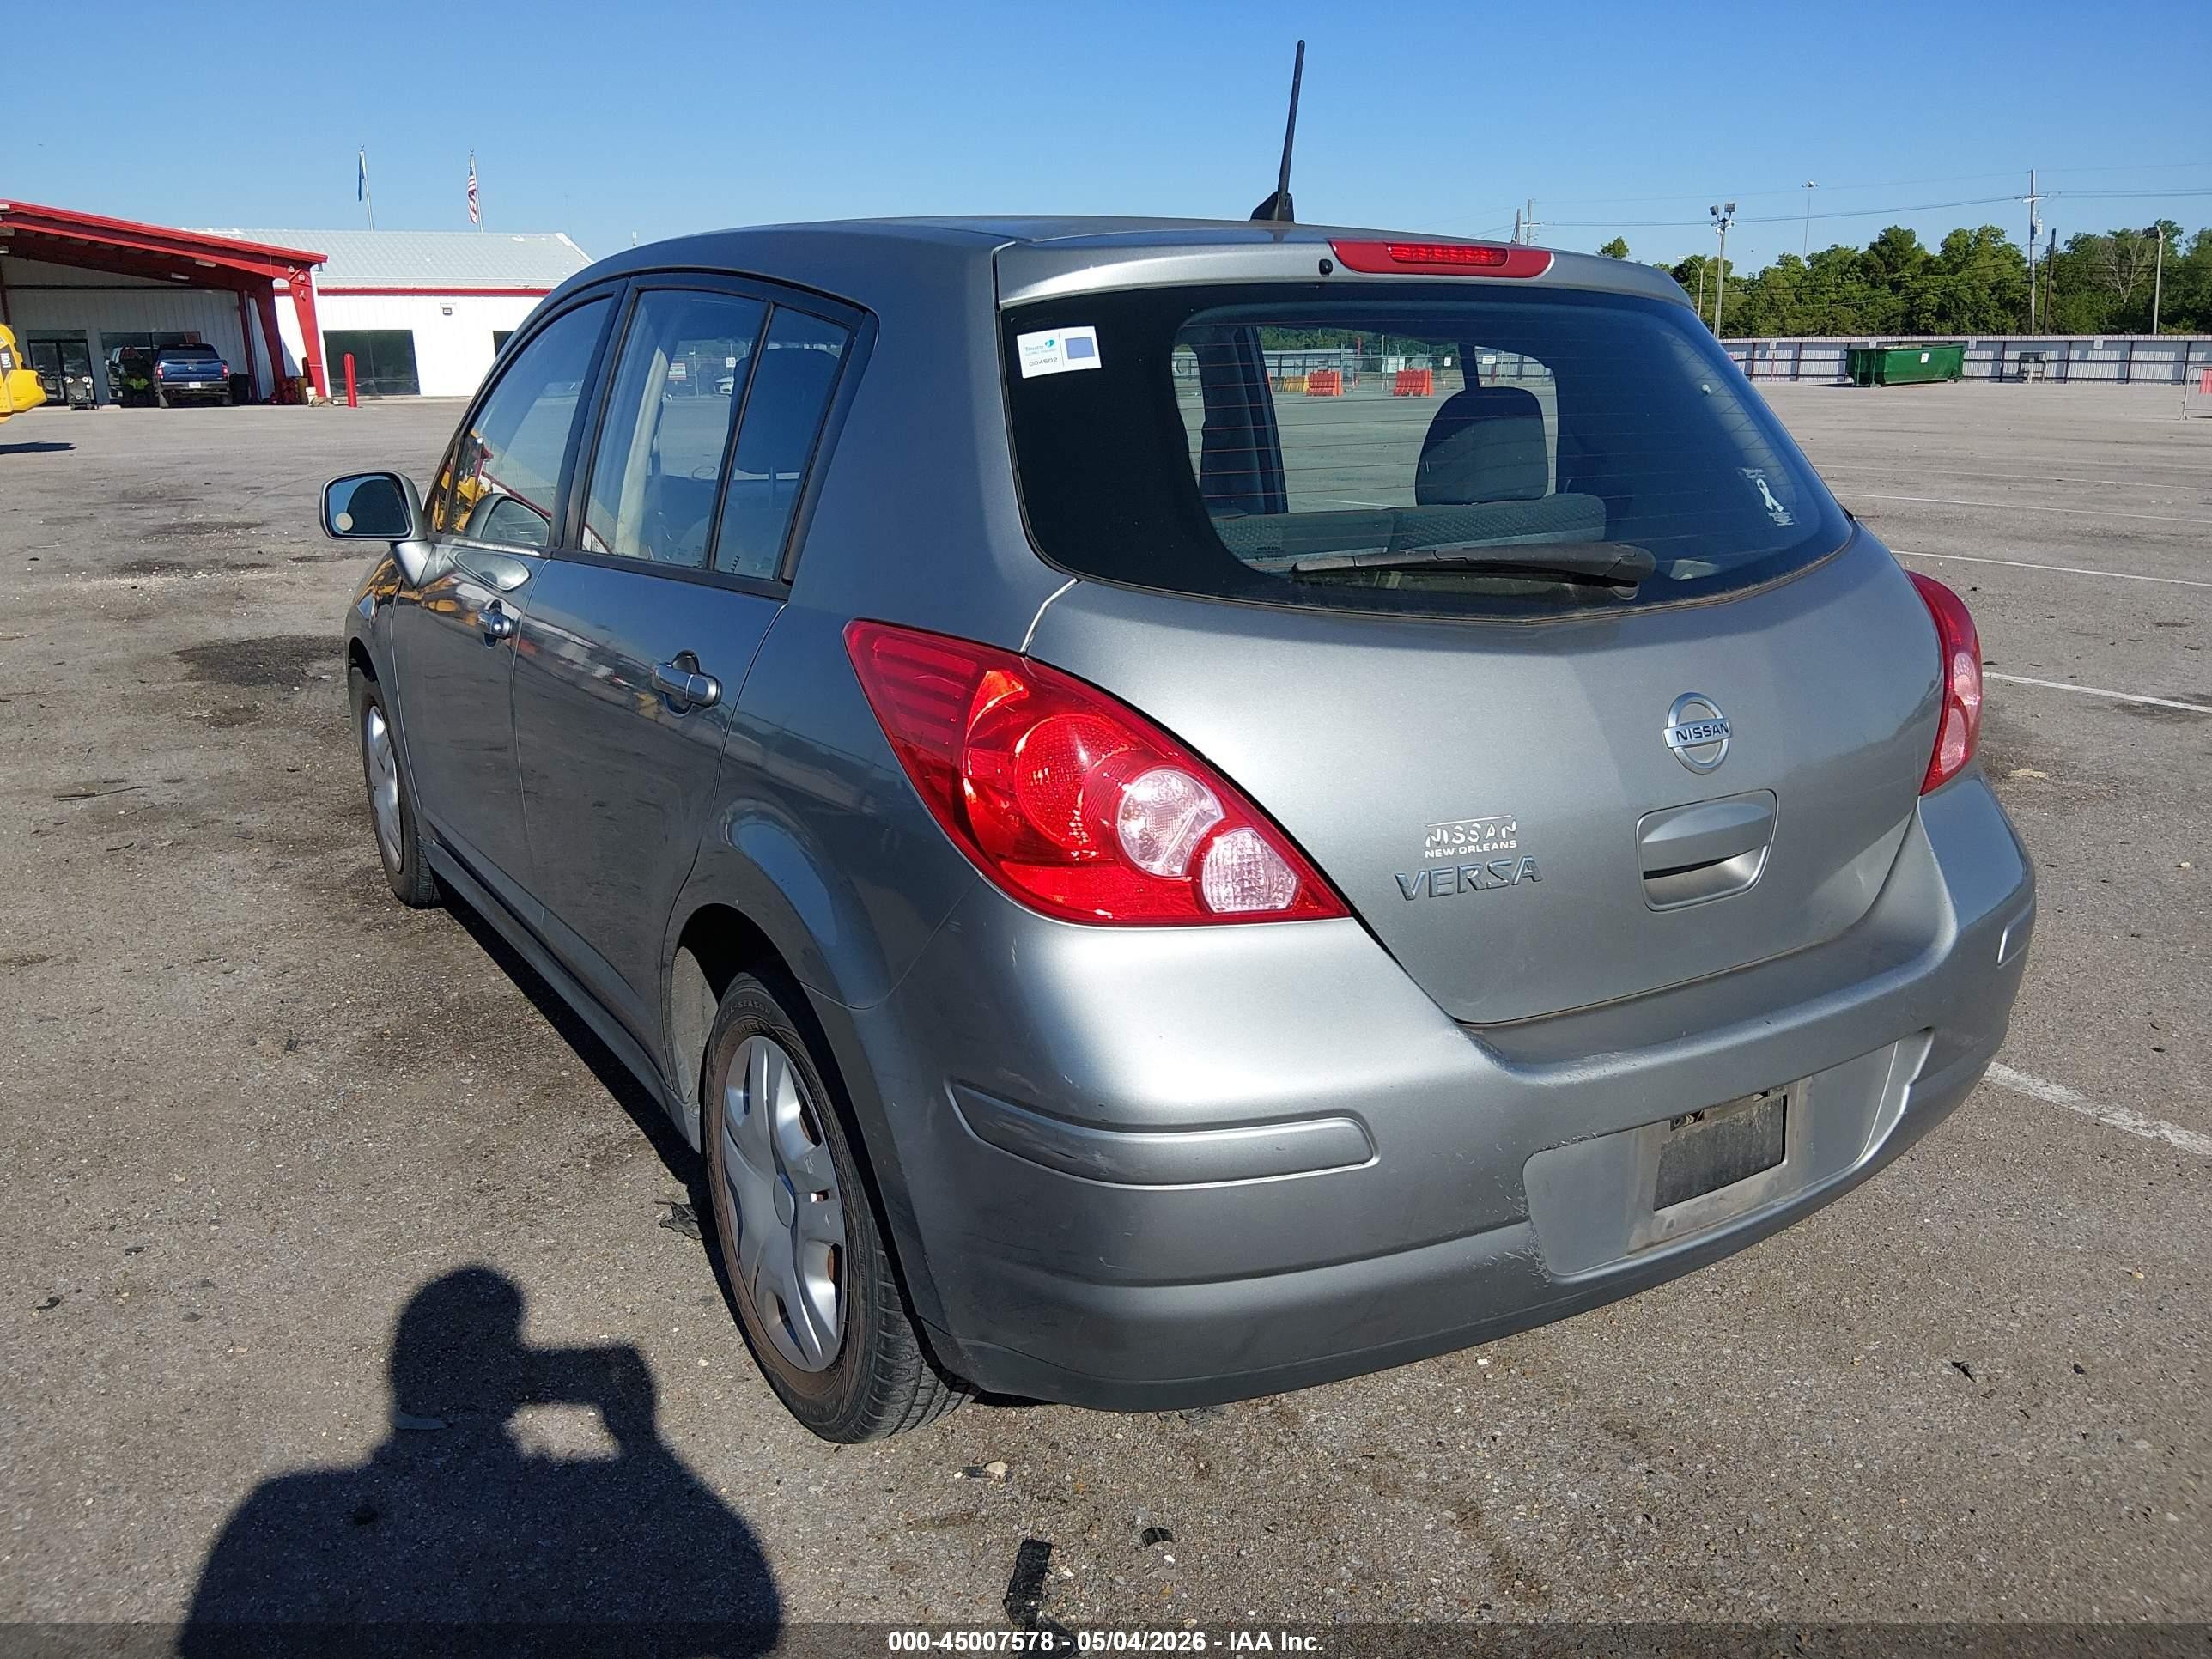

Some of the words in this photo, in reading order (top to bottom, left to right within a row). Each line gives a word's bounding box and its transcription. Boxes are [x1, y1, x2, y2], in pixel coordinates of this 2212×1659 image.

[1675, 723, 1729, 742] NISSAN
[1425, 819, 1517, 848] NISSAN
[1425, 847, 1455, 859] NEW
[1459, 840, 1517, 854] ORLEANS
[1395, 855, 1543, 901] VERSA
